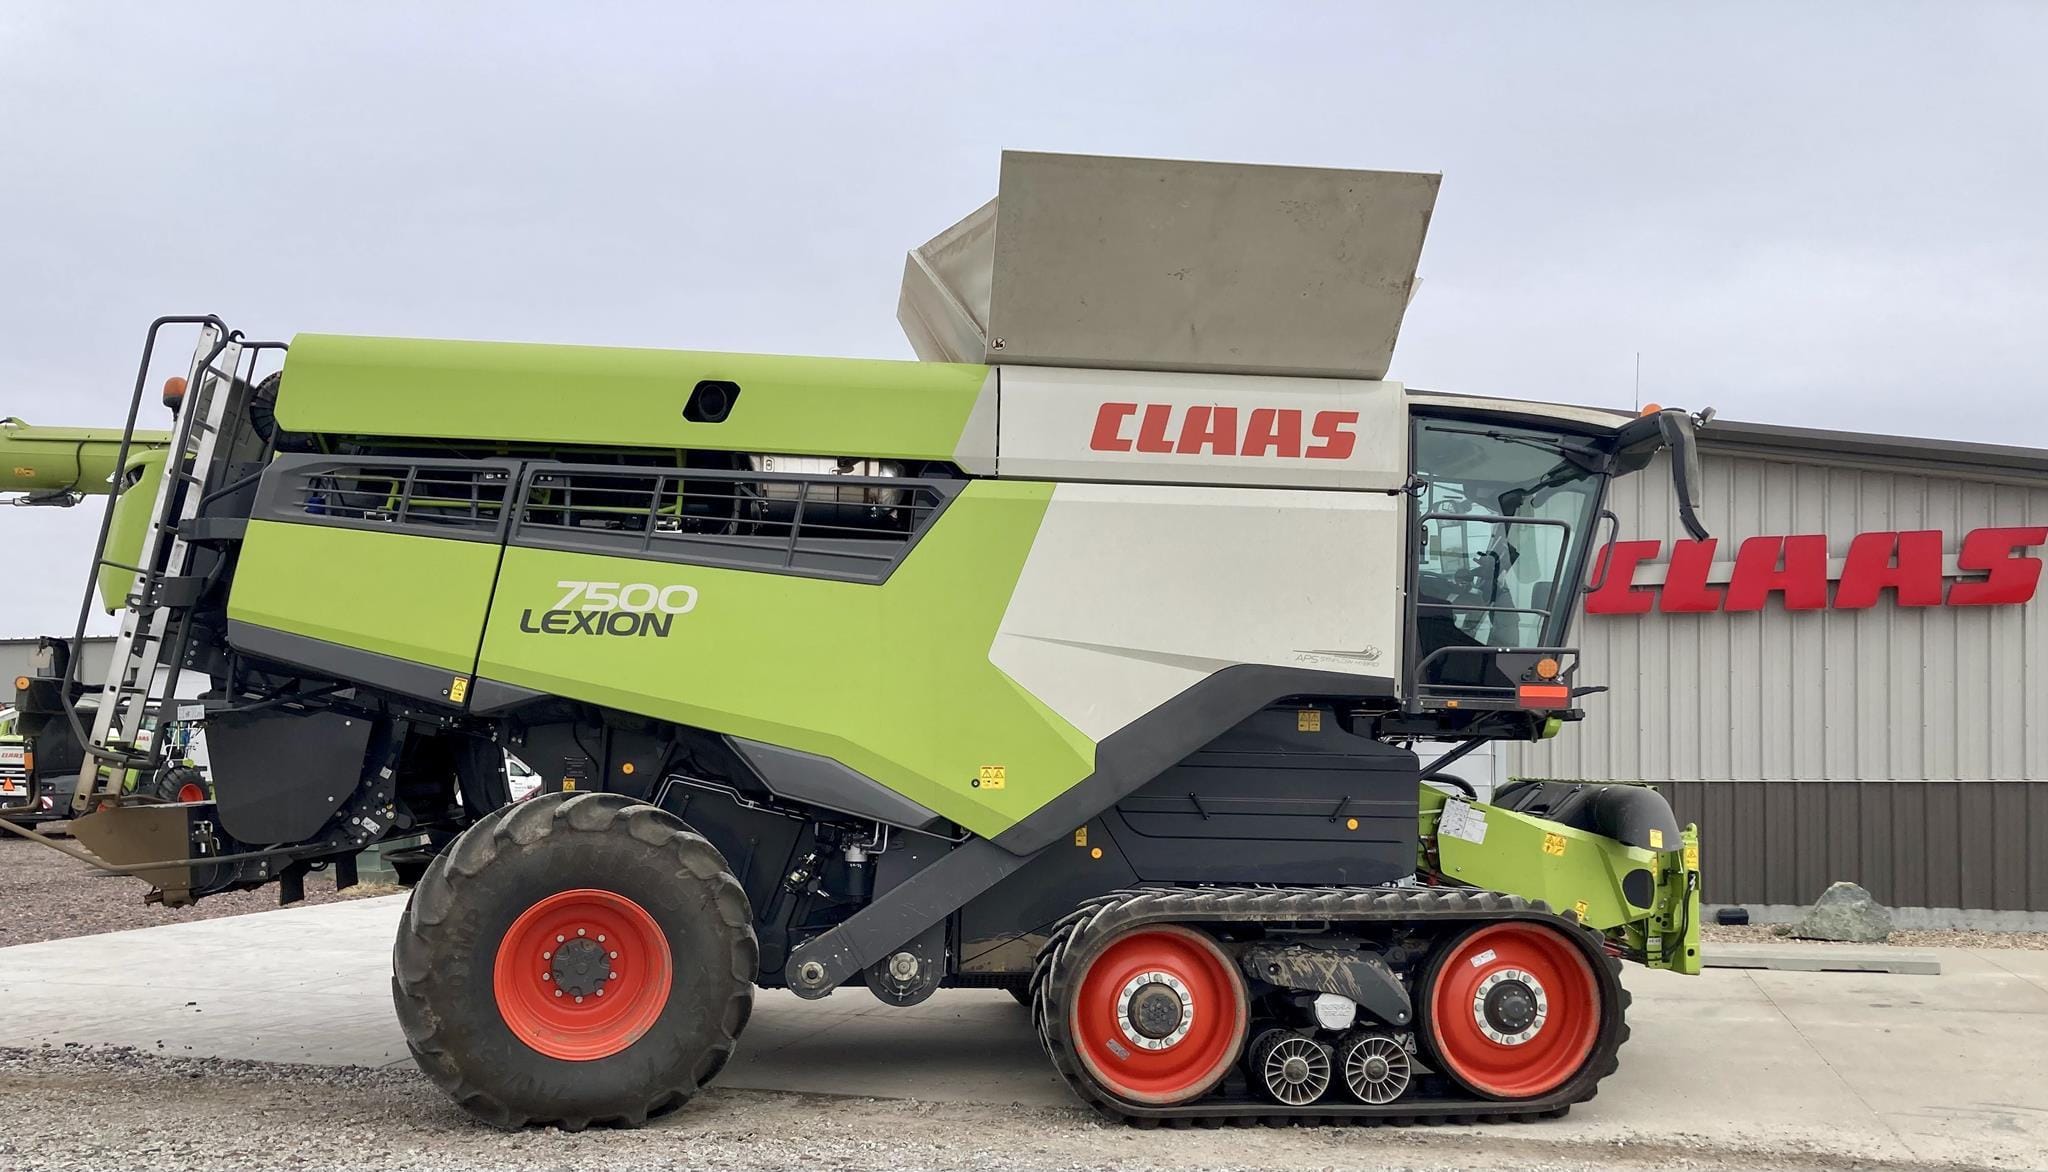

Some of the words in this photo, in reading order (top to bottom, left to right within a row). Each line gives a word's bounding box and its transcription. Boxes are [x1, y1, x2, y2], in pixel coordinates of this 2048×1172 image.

[1089, 402, 1360, 460] CLAAS
[1585, 526, 2048, 614] CLAAS
[551, 580, 699, 615] 7500
[519, 608, 675, 638] LEXION
[1295, 653, 1319, 664] APS
